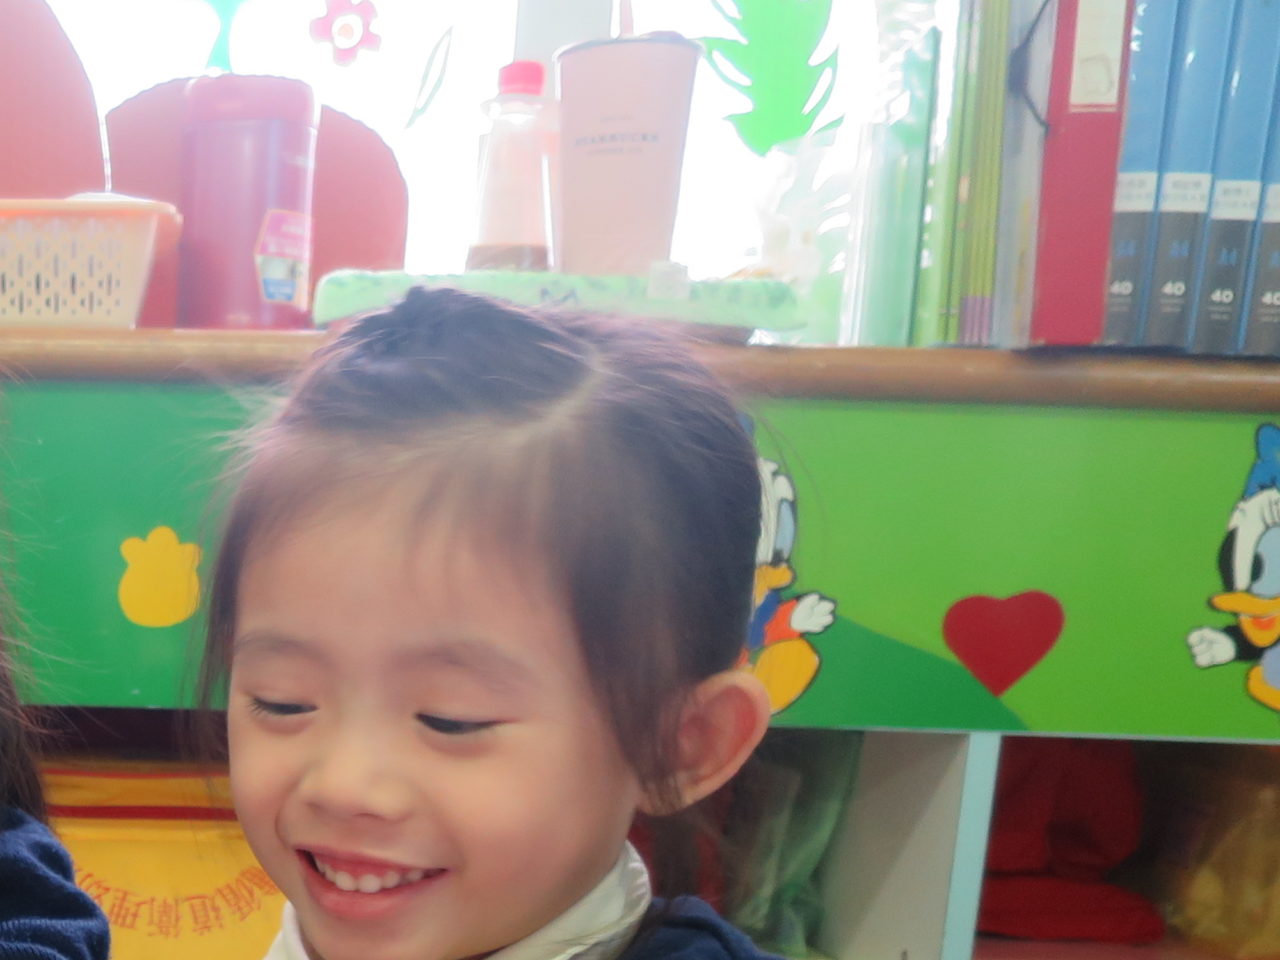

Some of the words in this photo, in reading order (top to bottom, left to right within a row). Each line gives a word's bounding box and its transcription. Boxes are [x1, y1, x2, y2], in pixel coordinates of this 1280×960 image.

[1109, 280, 1134, 296] 40
[1161, 281, 1186, 297] 40
[1210, 288, 1235, 304] 40
